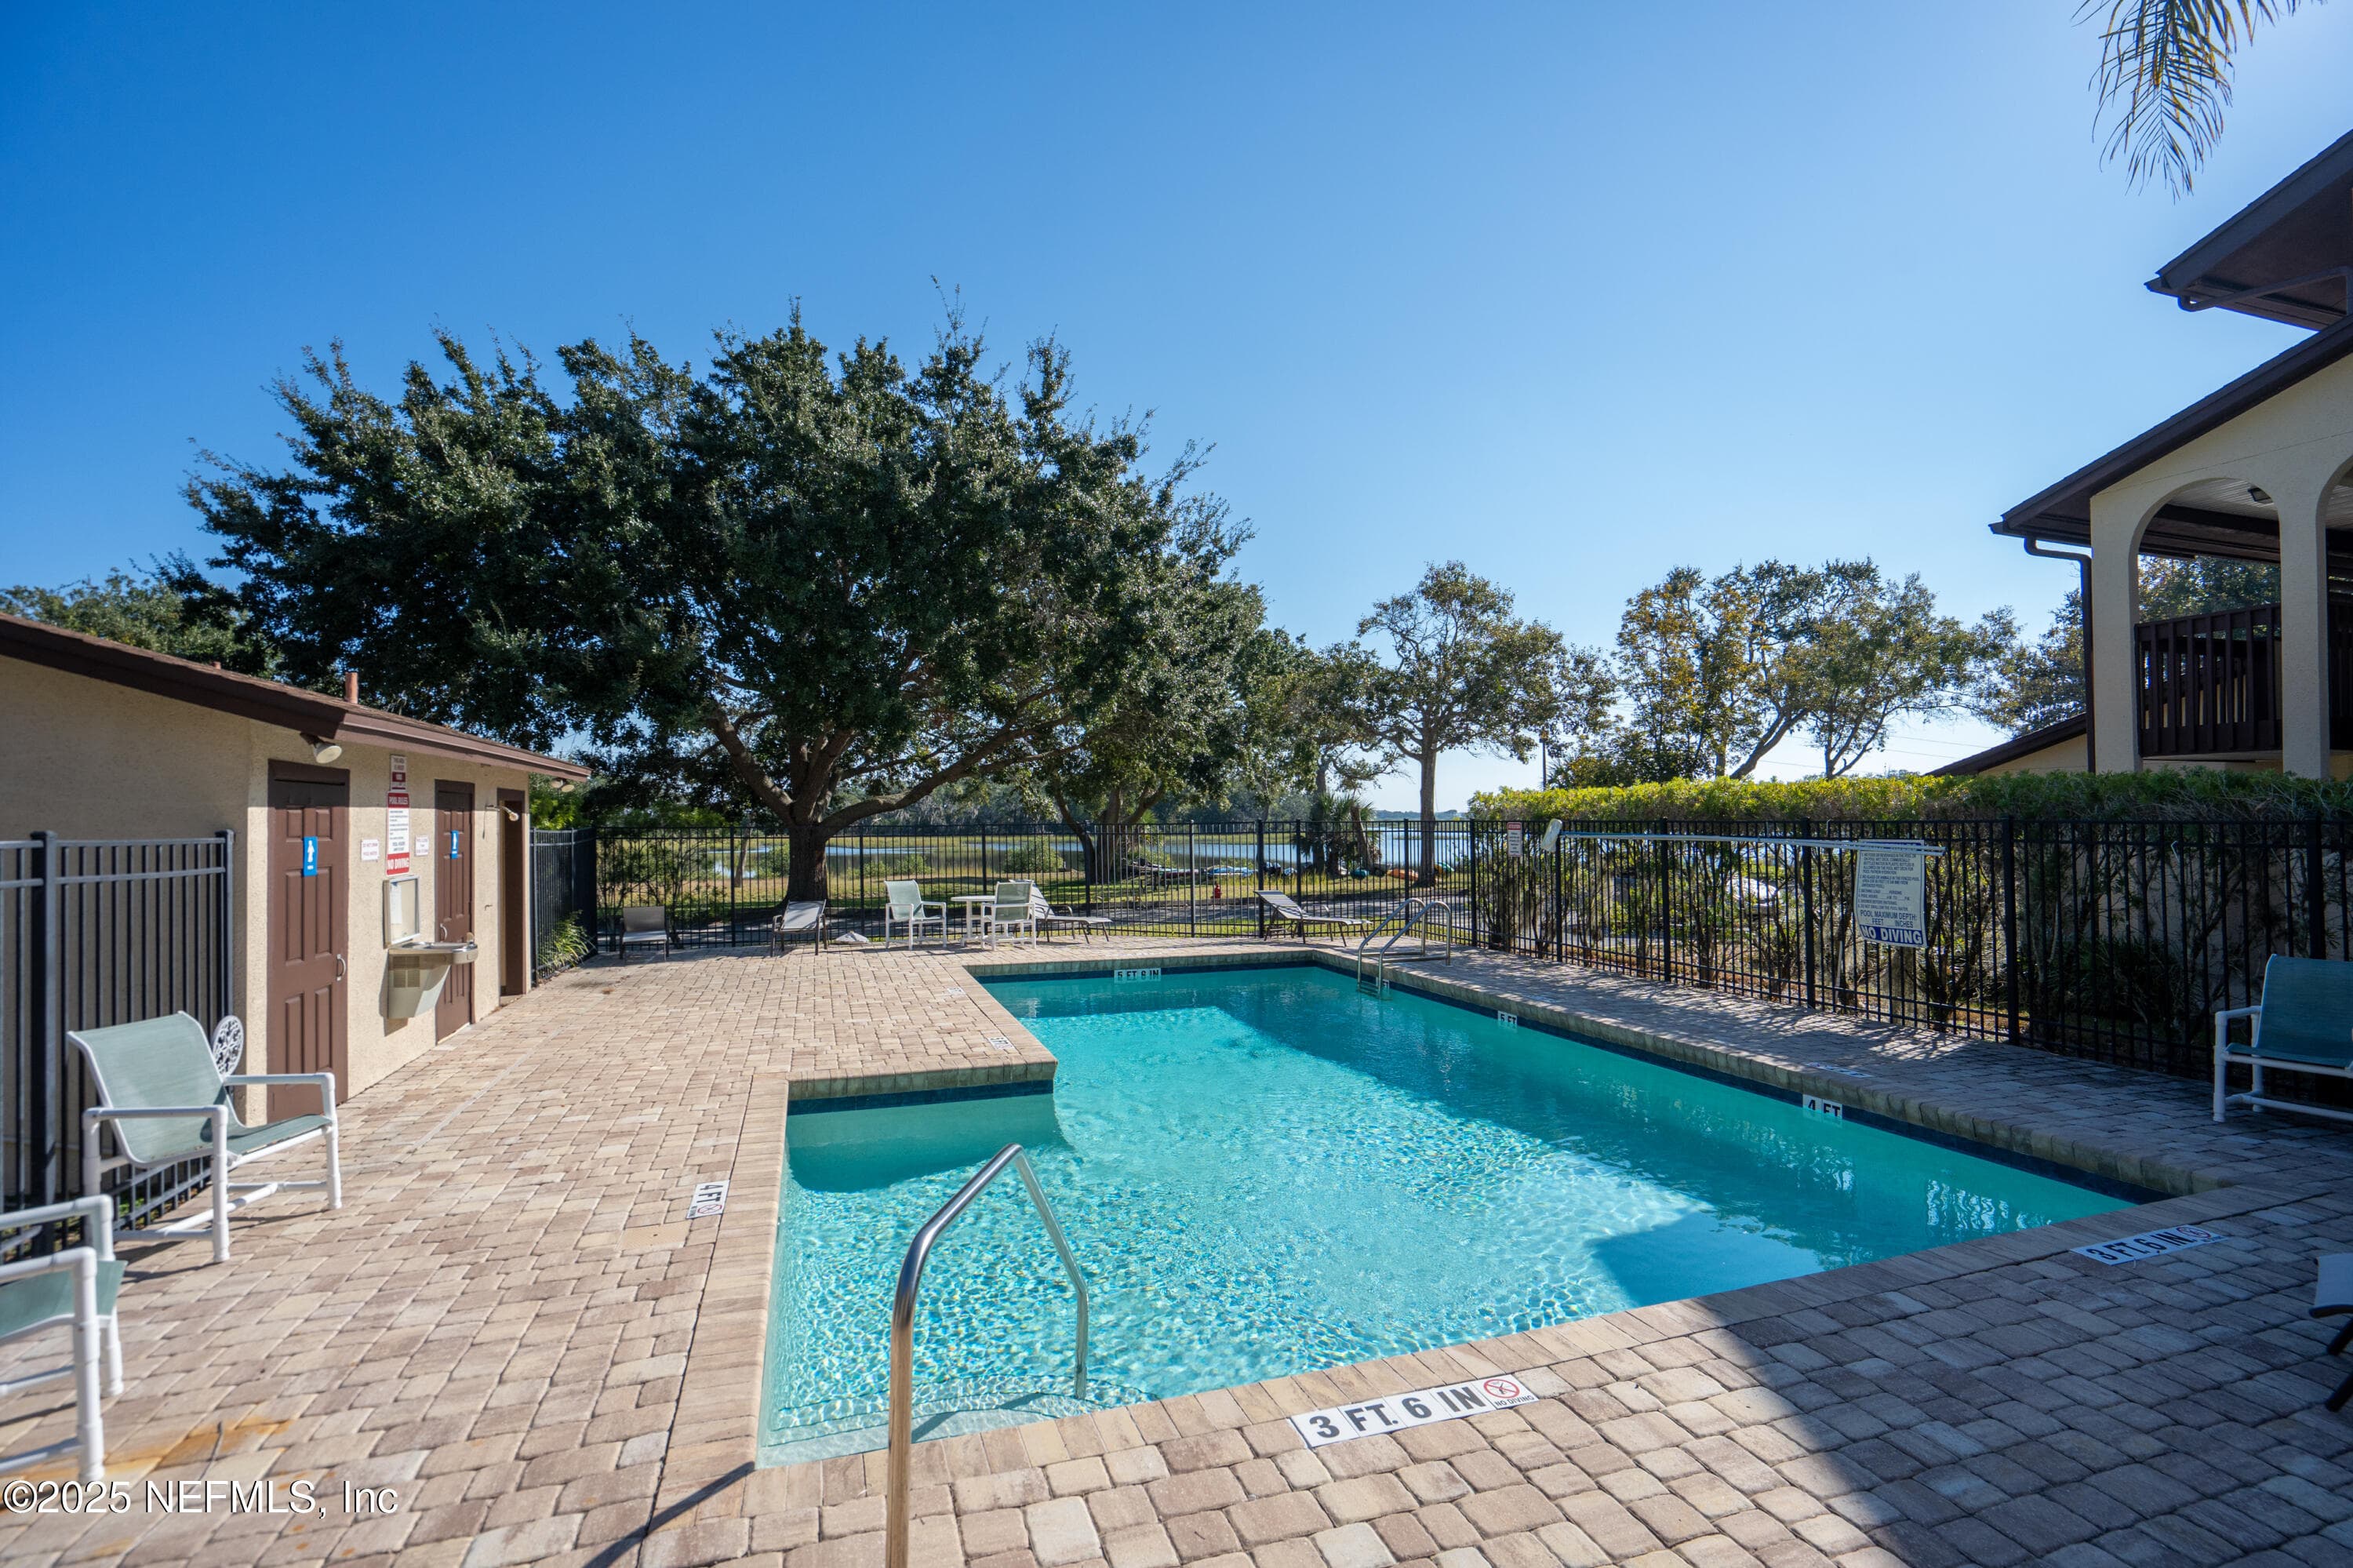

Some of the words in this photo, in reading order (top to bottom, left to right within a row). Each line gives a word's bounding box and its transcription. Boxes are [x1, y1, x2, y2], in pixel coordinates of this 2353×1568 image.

[1894, 919, 1914, 929] INCHES
[1860, 926, 1877, 940] NO
[1880, 927, 1922, 944] DIVING
[696, 1191, 722, 1203] FT
[2086, 1248, 2119, 1261] 3
[2133, 1238, 2167, 1250] 6
[1507, 1395, 1535, 1404] DIVING
[1309, 1415, 1340, 1439] 3
[1344, 1403, 1398, 1432] FT.
[1402, 1397, 1432, 1419] 6
[1437, 1386, 1486, 1412] IN
